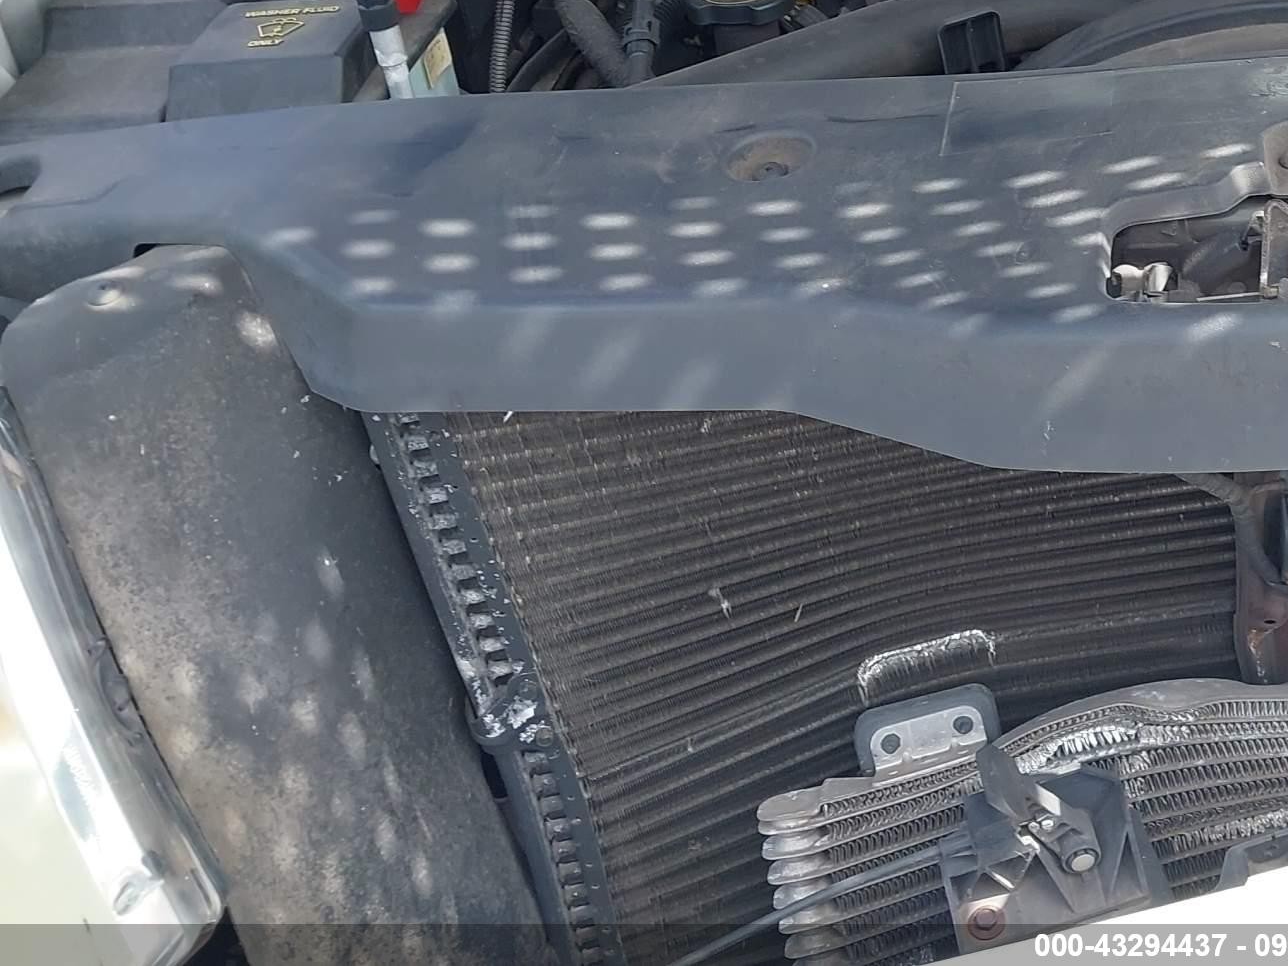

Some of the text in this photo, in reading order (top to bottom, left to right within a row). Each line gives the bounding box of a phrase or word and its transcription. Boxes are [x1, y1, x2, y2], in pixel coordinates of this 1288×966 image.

[244, 5, 341, 19] WASHER FLUID
[247, 38, 285, 48] ONLY
